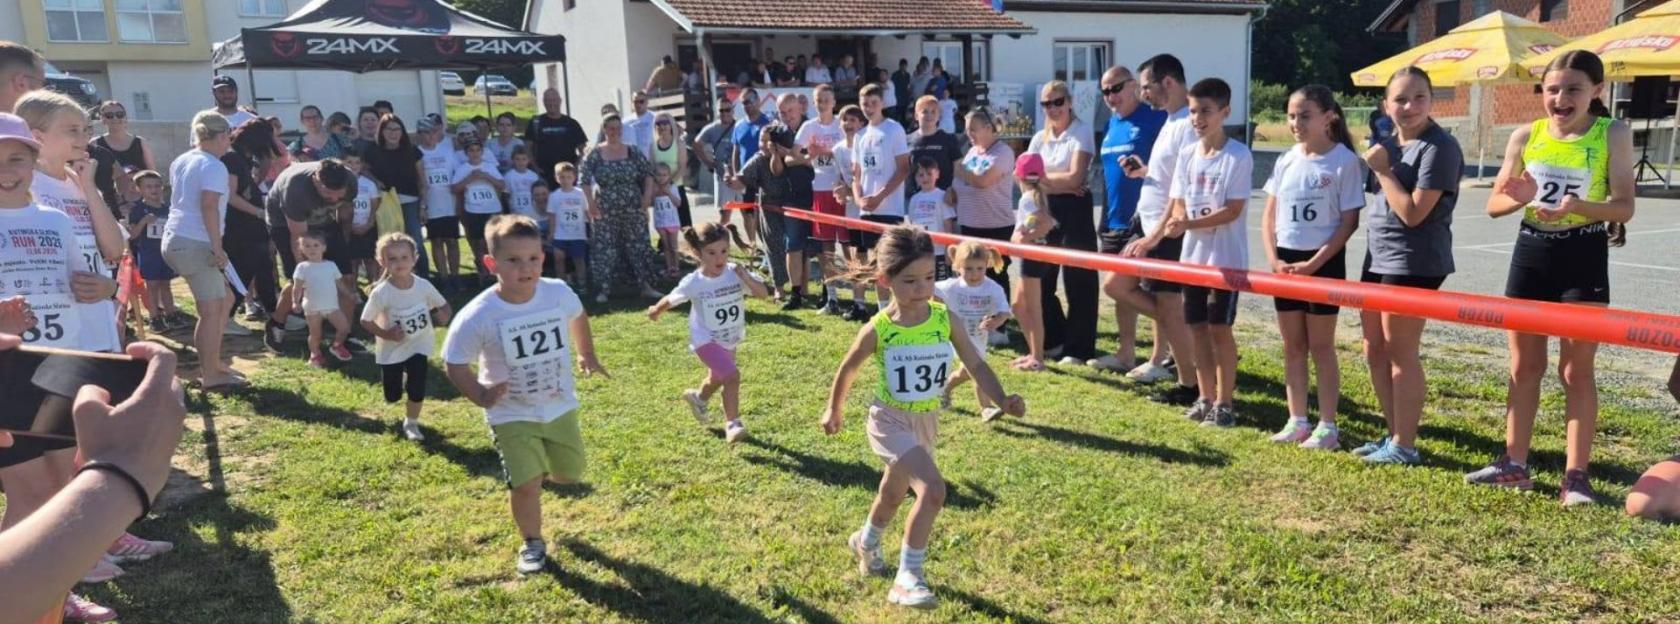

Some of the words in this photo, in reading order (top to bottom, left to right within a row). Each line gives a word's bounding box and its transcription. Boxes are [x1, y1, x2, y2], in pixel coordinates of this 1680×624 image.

[306, 38, 399, 54] 24MX
[465, 39, 546, 55] 24MX
[428, 174, 449, 184] 128
[472, 191, 493, 200] 130
[1540, 181, 1581, 204] 25
[563, 211, 579, 221] 78
[1291, 202, 1317, 222] 16
[1580, 224, 1606, 236] NIK
[11, 235, 37, 248] RUN
[38, 235, 63, 249] 2026
[715, 304, 739, 326] 99
[1458, 306, 1504, 324] POZOR
[511, 325, 564, 359] 121
[893, 361, 947, 393] 134
